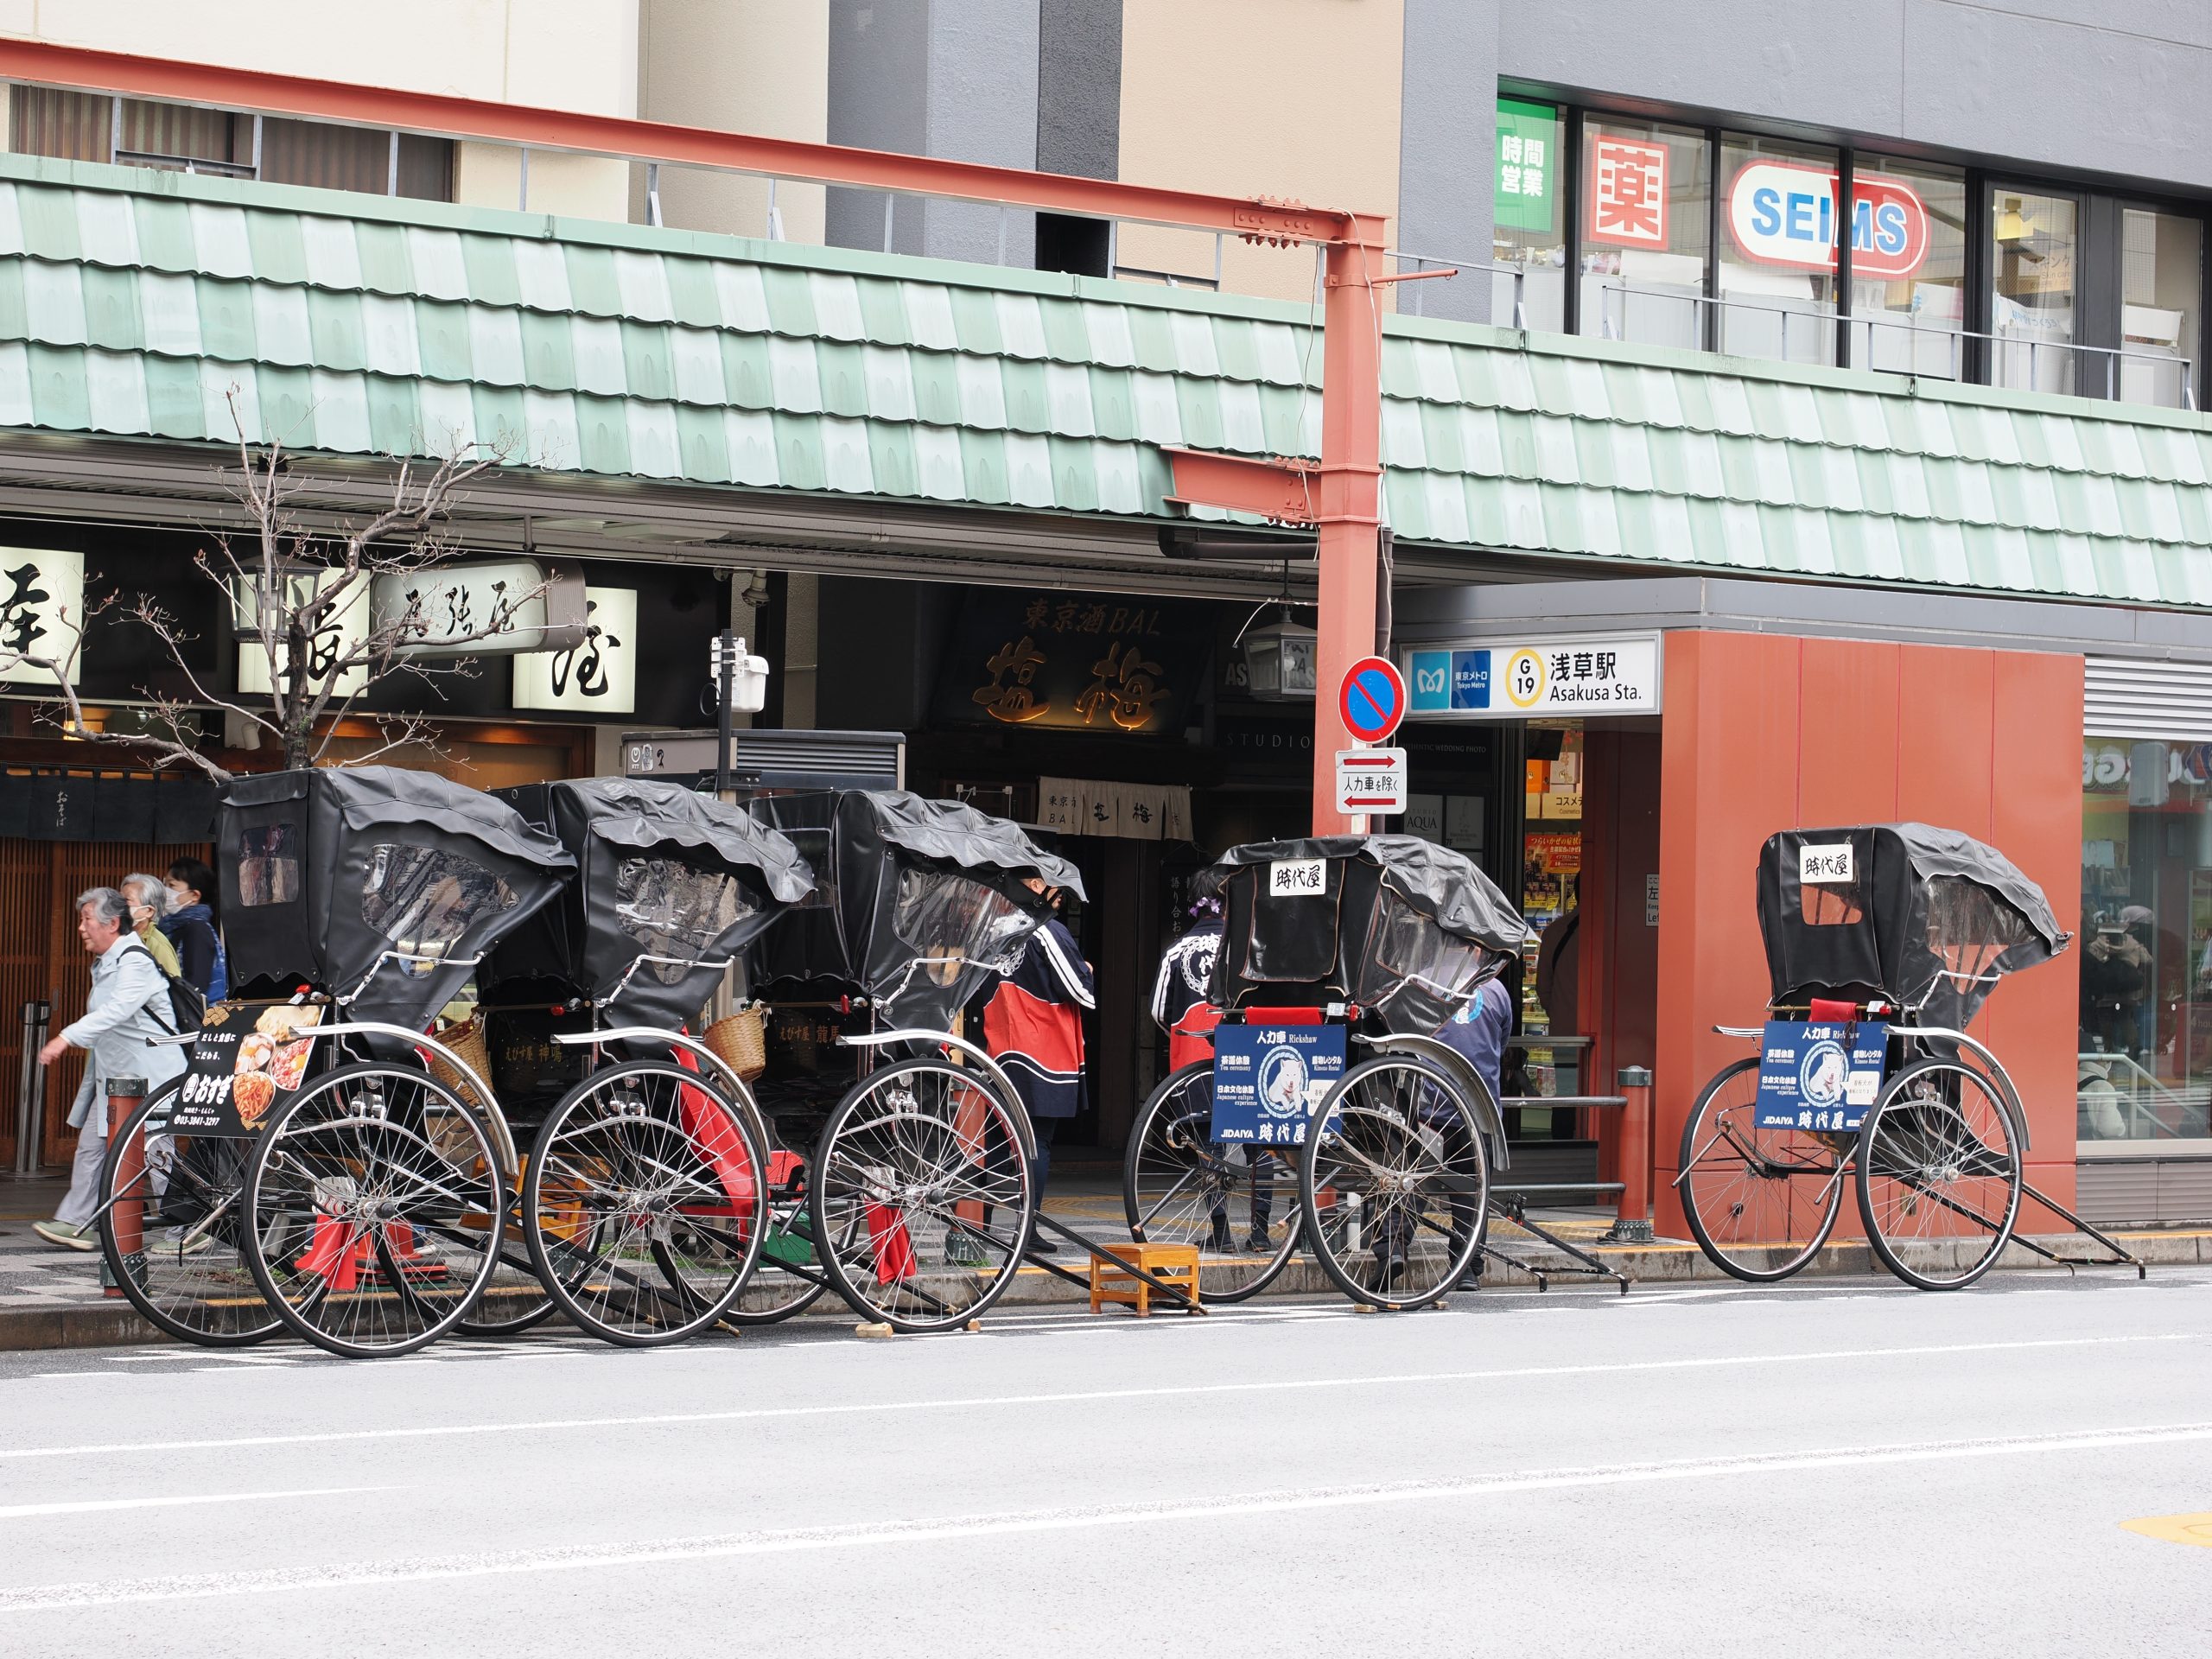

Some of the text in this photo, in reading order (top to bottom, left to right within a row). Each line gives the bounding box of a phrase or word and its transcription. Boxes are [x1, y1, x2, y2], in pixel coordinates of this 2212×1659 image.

[1501, 135, 1545, 168] 時間
[1501, 165, 1543, 198] 営業
[1599, 147, 1661, 237] 薬
[1751, 188, 1907, 254] SEIMS
[1520, 658, 1531, 675] G
[1549, 652, 1617, 681] 浅草駅
[1454, 671, 1488, 682] 東京メトロ
[1457, 682, 1471, 690] Tokyo
[1517, 677, 1535, 695] 19
[1549, 683, 1643, 702] Asakusa Sta.
[1344, 775, 1398, 792] 人力車を除く
[55, 791, 68, 828] おそば
[1407, 816, 1438, 831] AQUA
[1804, 853, 1848, 876] 時代屋
[1274, 864, 1321, 890] 時代屋
[1256, 1030, 1318, 1045] 人力車 Rickshaw
[1802, 1027, 1831, 1040] 人力車
[1763, 1116, 1794, 1125] JIDAIYA
[1797, 1109, 1845, 1130] 時代屋
[1220, 1128, 1254, 1139] JIDAIYA
[1258, 1122, 1306, 1143] 時代屋
